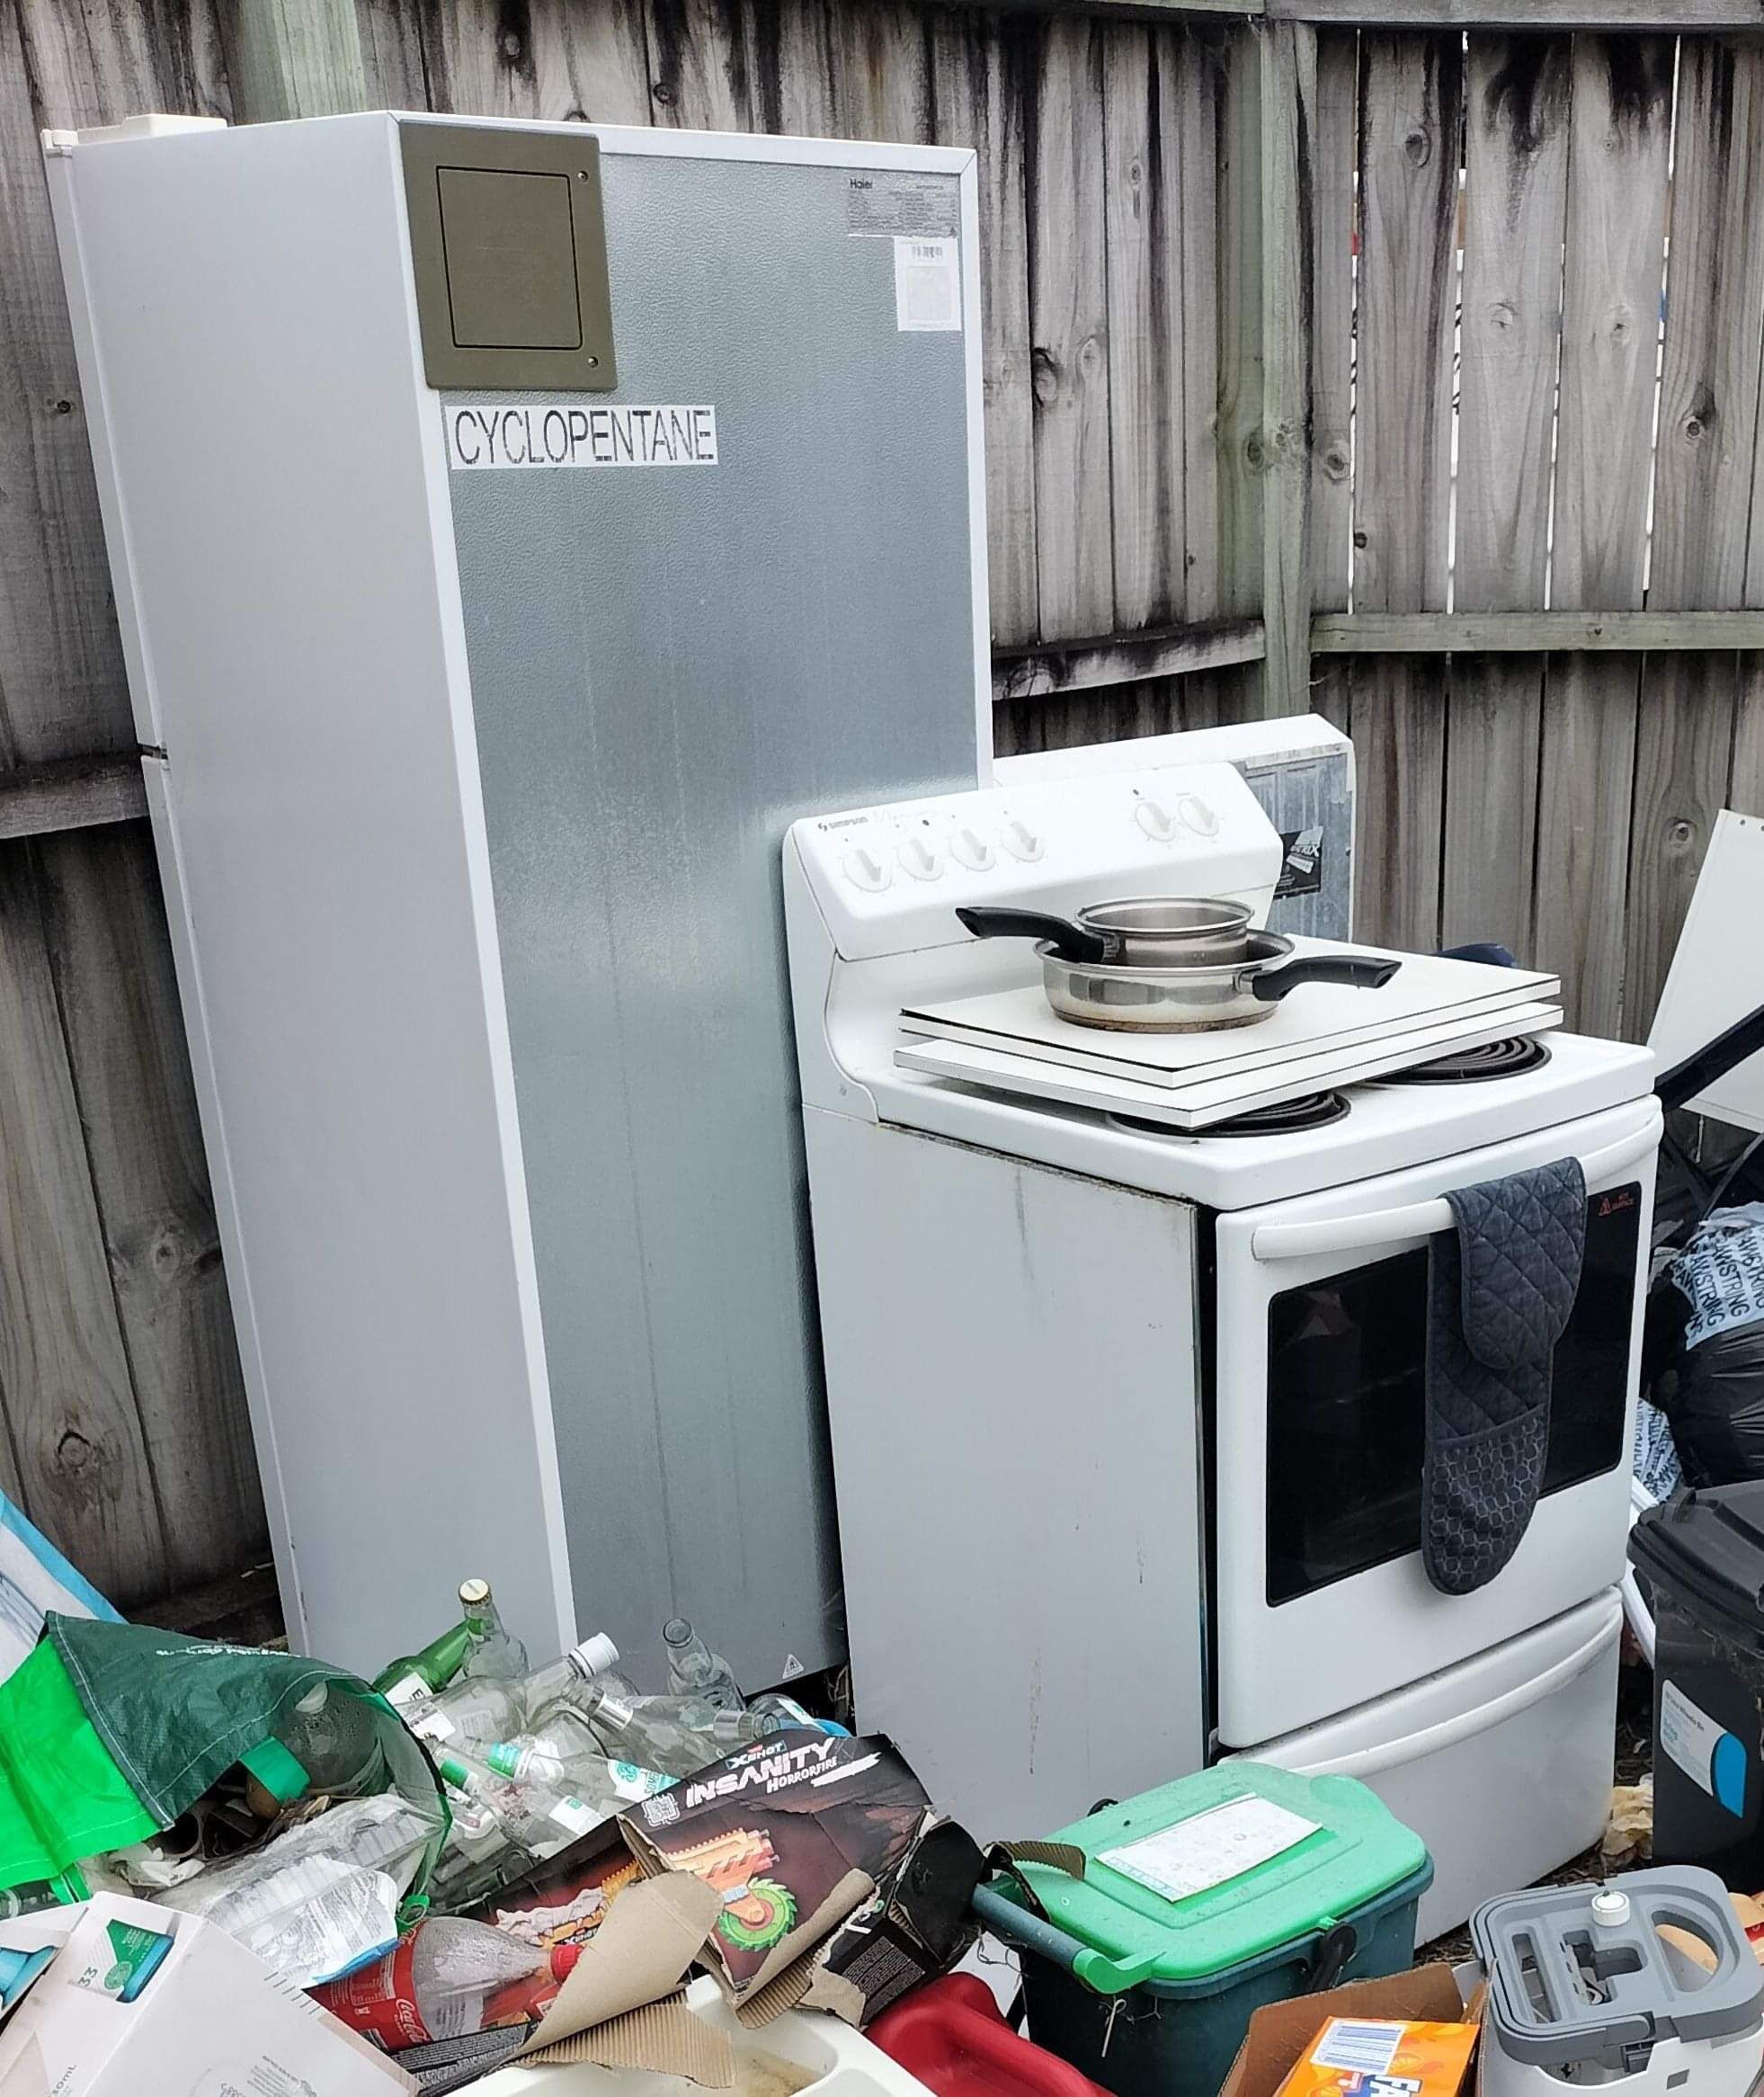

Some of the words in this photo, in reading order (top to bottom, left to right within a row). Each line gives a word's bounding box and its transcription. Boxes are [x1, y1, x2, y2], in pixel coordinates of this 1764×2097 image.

[849, 178, 872, 189] Haier
[455, 409, 715, 465] CYCLOPENTANE
[686, 1736, 835, 1808] INSANITY
[766, 1756, 837, 1794] HORRORFIRE
[78, 1967, 98, 1987] 33
